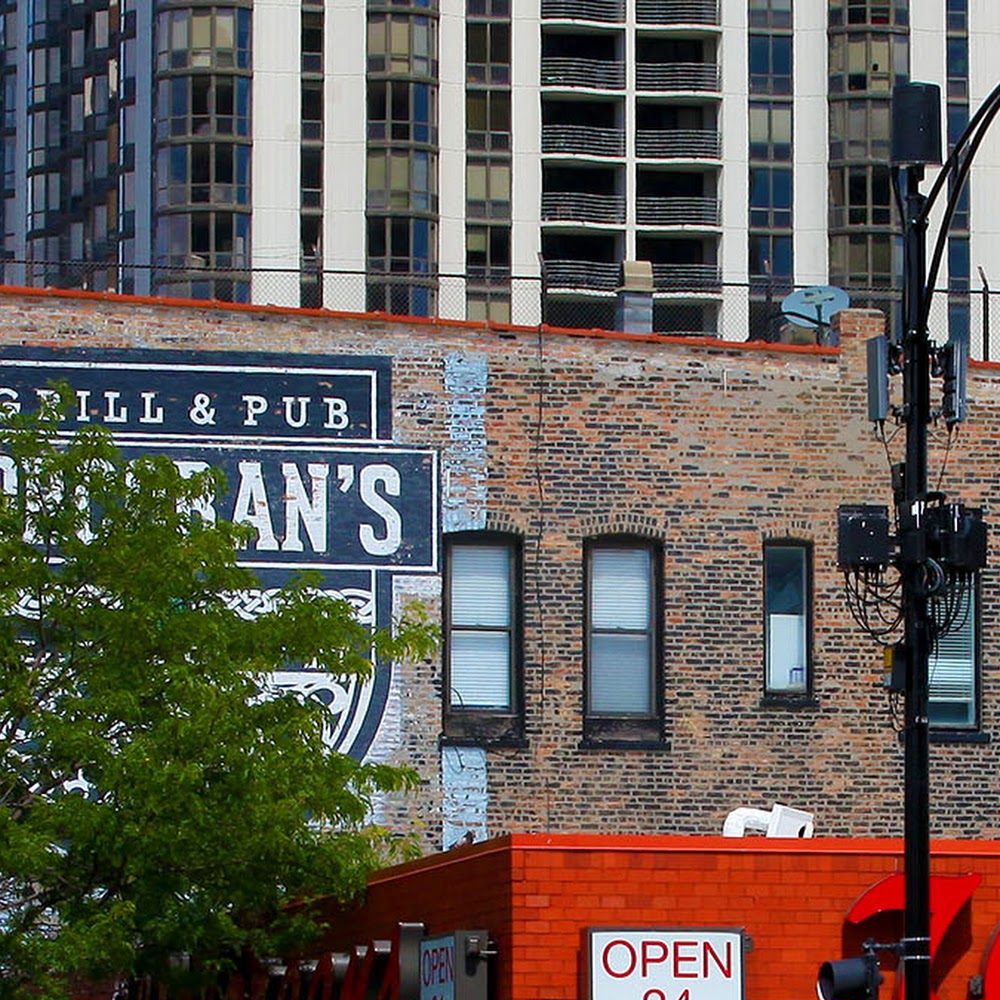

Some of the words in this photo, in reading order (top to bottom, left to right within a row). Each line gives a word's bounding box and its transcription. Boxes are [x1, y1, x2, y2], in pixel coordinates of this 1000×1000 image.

[0, 387, 164, 423] GRILL
[189, 393, 216, 425] &
[242, 395, 351, 429] PUB
[423, 945, 454, 986] OPEN
[602, 939, 732, 979] OPEN
